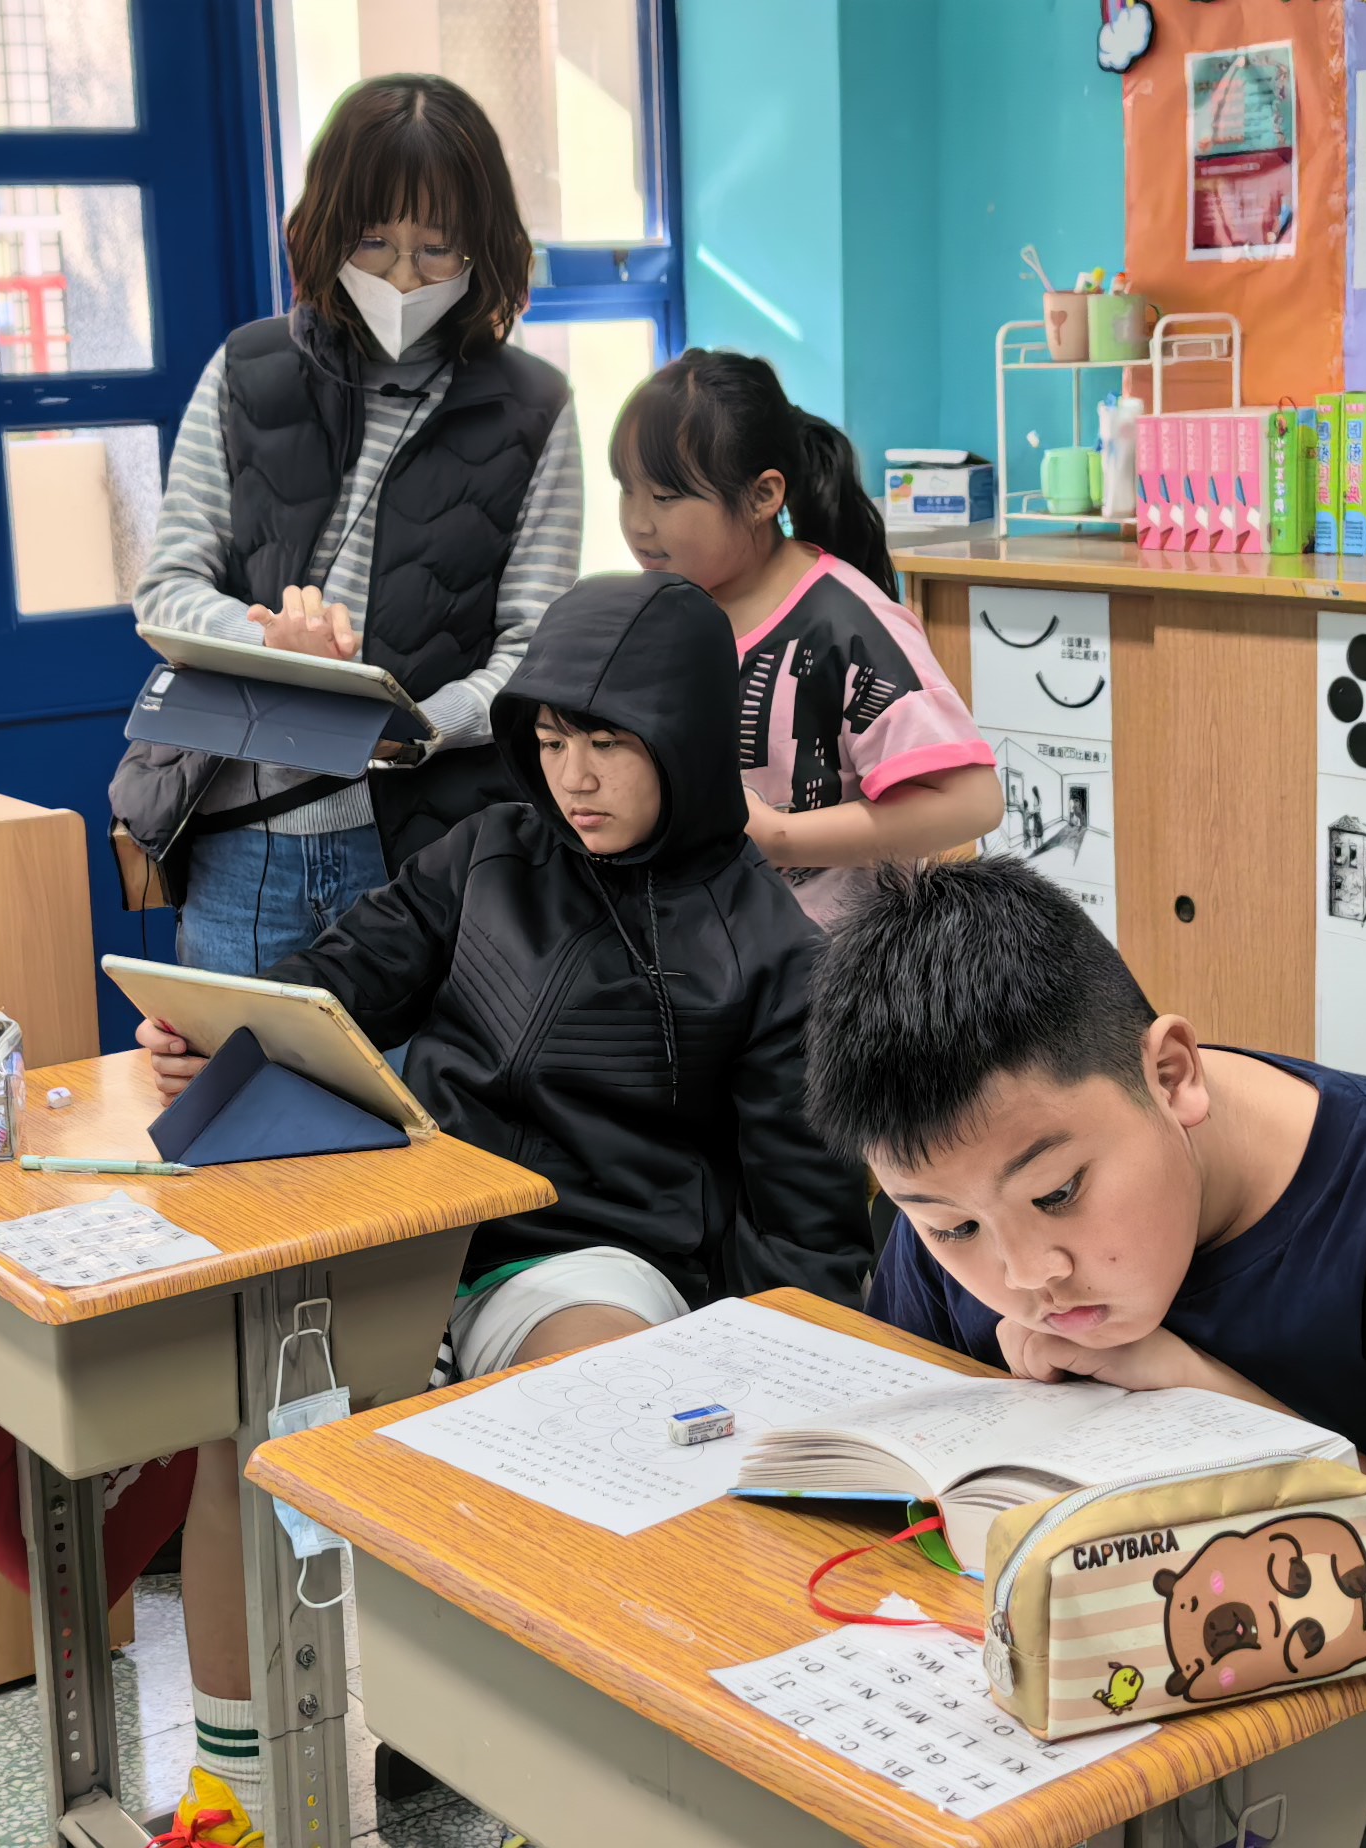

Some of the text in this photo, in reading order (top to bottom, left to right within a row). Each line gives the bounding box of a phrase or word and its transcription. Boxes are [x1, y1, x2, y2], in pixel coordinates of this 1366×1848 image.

[1073, 1528, 1180, 1571] CAPYBARA
[836, 1644, 859, 1661] Tt
[914, 1651, 946, 1673] Ww
[798, 1656, 826, 1673] Oo
[769, 1671, 797, 1690] Jj
[886, 1666, 912, 1684] Ss
[849, 1680, 881, 1700] Nn
[934, 1692, 964, 1710] Rr
[895, 1701, 933, 1724] Mm
[863, 1718, 897, 1741] Hh
[983, 1716, 1015, 1737] Qq
[742, 1685, 966, 1804] Aa Bb Cc Dd Ee
[946, 1731, 981, 1749] Ll
[916, 1742, 947, 1765] Gg
[962, 1771, 996, 1790] Ff
